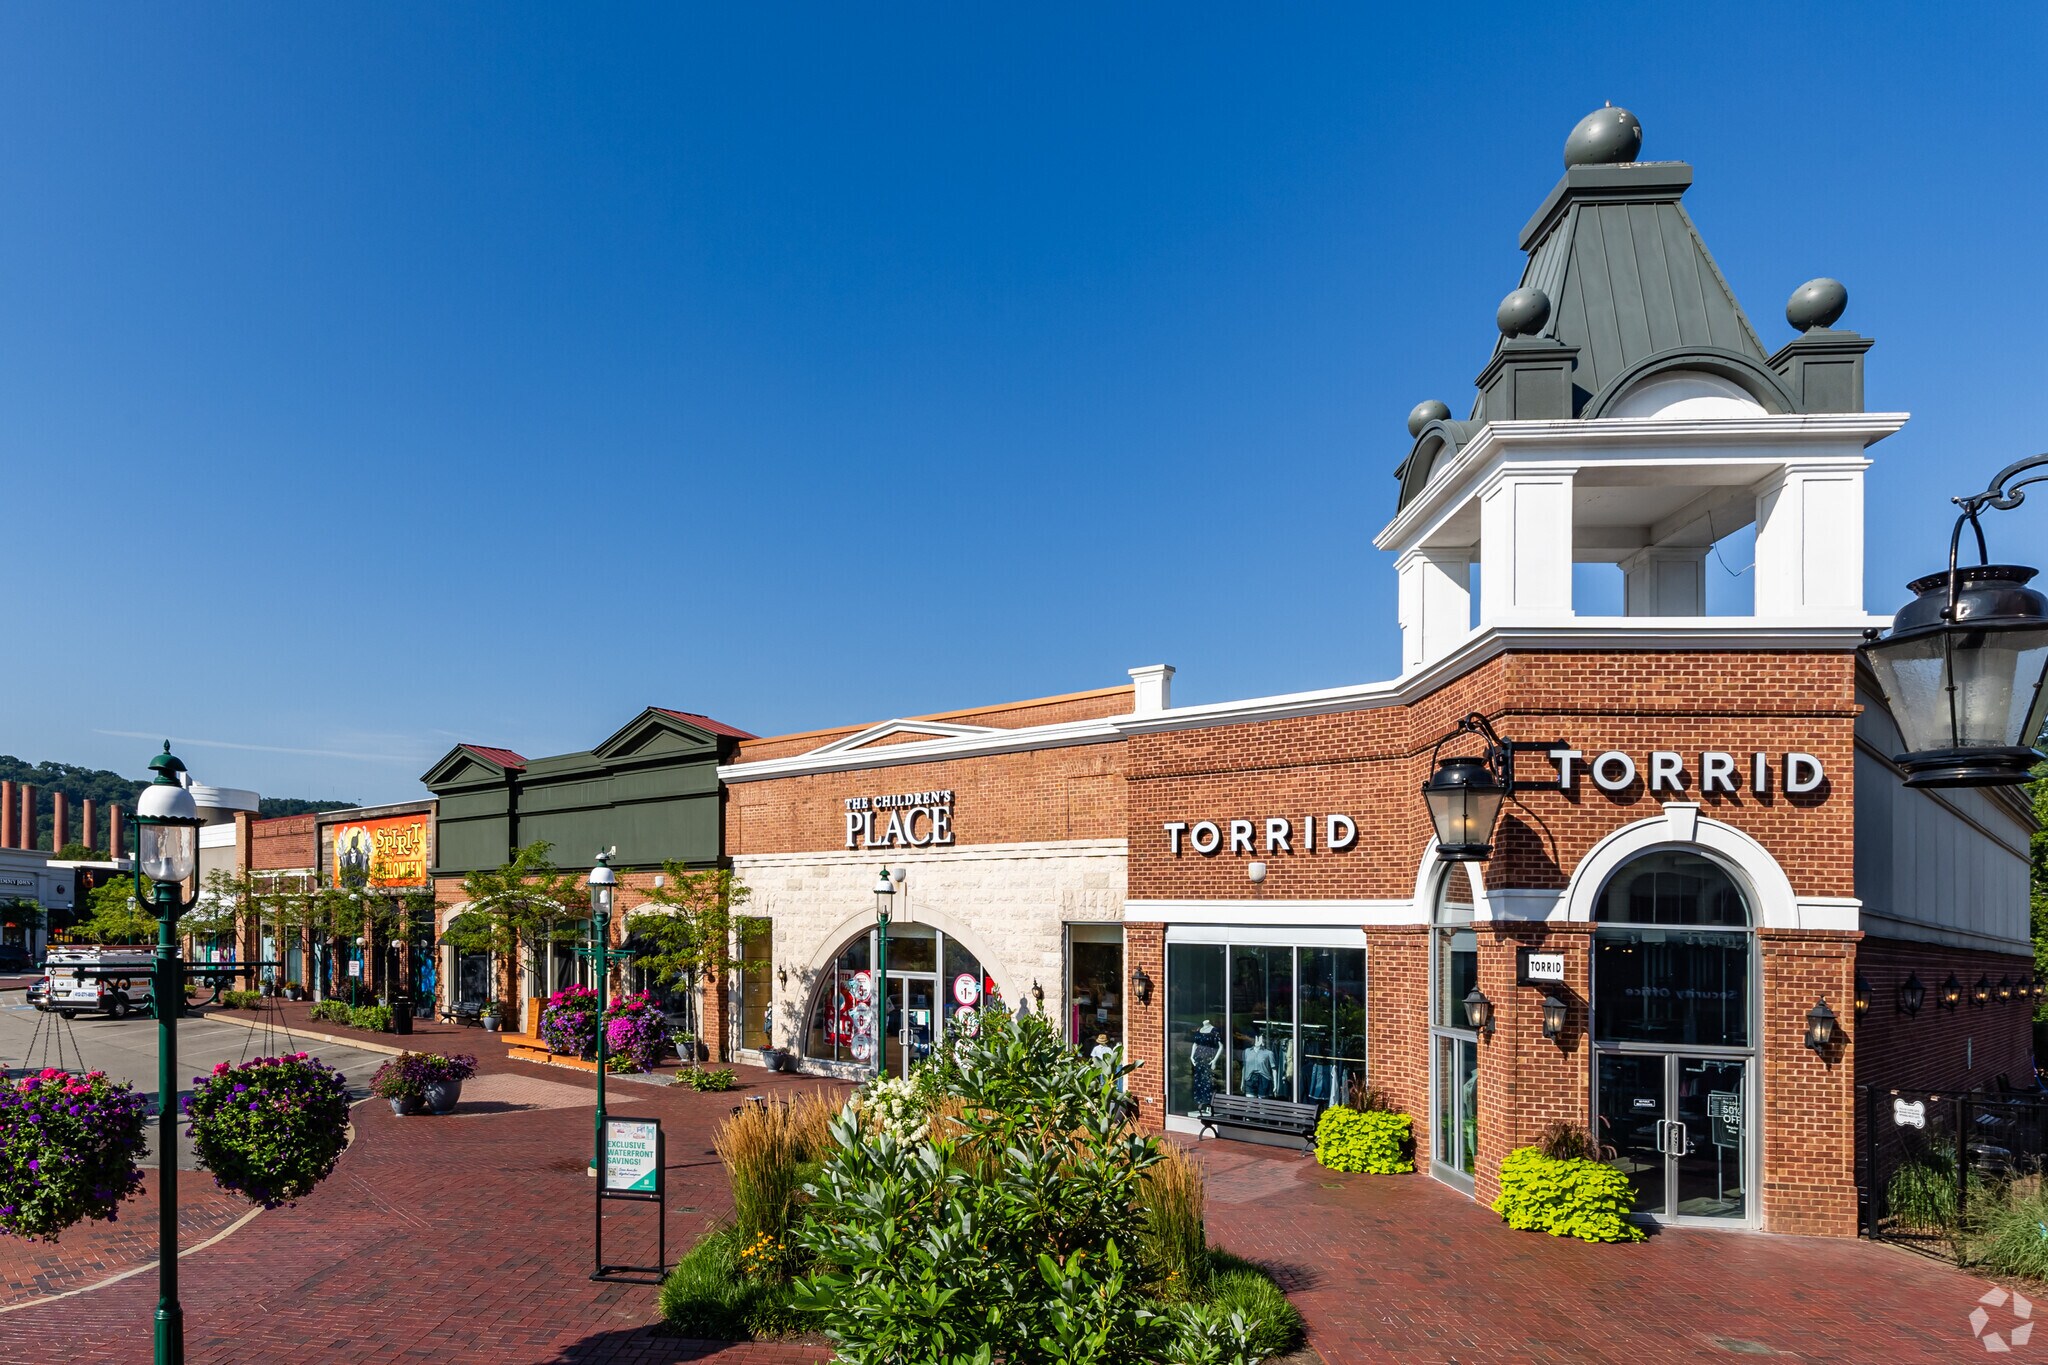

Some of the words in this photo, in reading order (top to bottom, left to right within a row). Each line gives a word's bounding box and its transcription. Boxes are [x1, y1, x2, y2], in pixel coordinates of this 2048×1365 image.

[1550, 749, 1823, 794] TORRID
[845, 797, 868, 810] THE
[872, 790, 952, 809] CHILDREN'S
[845, 806, 953, 848] PLACE
[1163, 814, 1358, 855] TORRID
[376, 822, 422, 856] SPIRIT
[1530, 959, 1562, 975] TORRID
[828, 1018, 851, 1036] SLE
[1723, 1114, 1741, 1125] OFF
[607, 1141, 646, 1149] EXCLUSIVE
[607, 1149, 654, 1158] WATERFRONT
